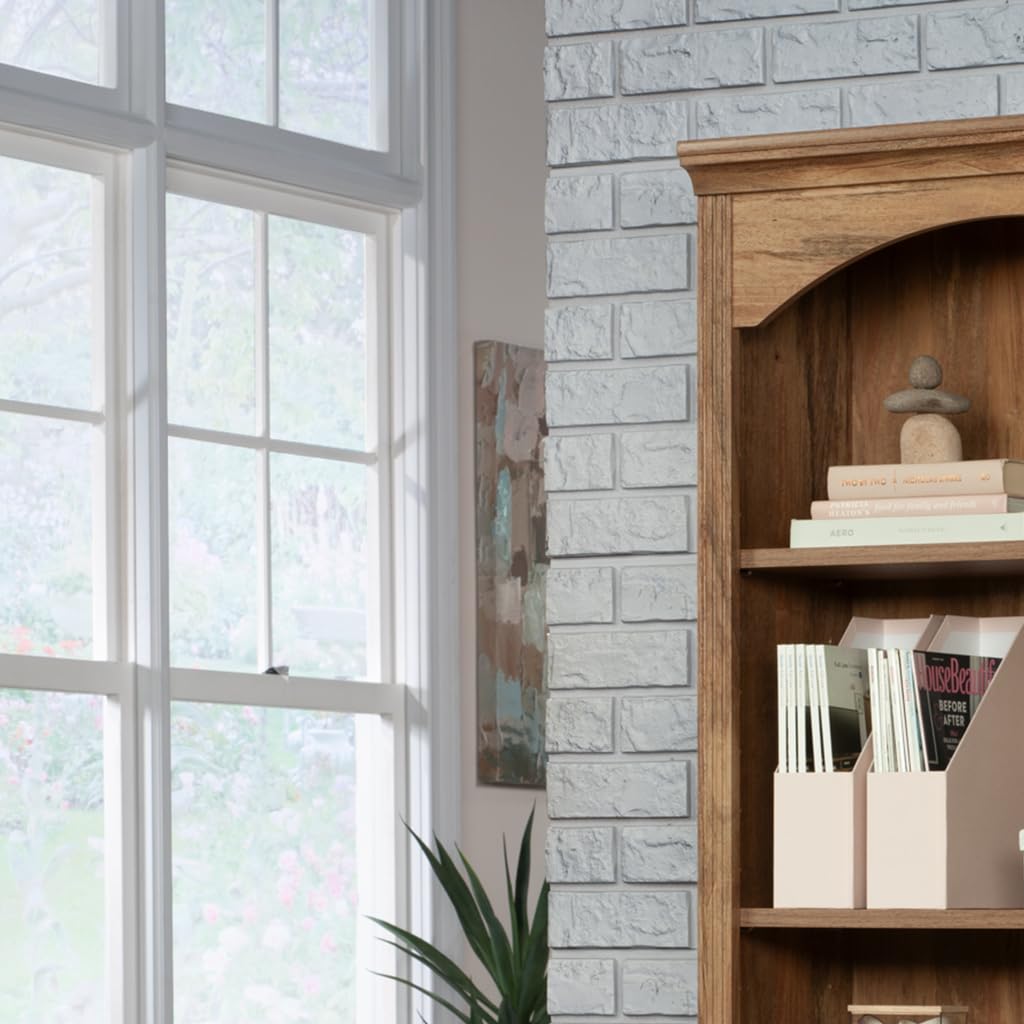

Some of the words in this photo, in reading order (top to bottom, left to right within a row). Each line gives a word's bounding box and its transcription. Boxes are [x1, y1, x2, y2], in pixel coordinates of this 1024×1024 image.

[830, 528, 855, 538] AERO
[938, 699, 968, 713] BEFORE
[943, 714, 965, 727] AFTER
